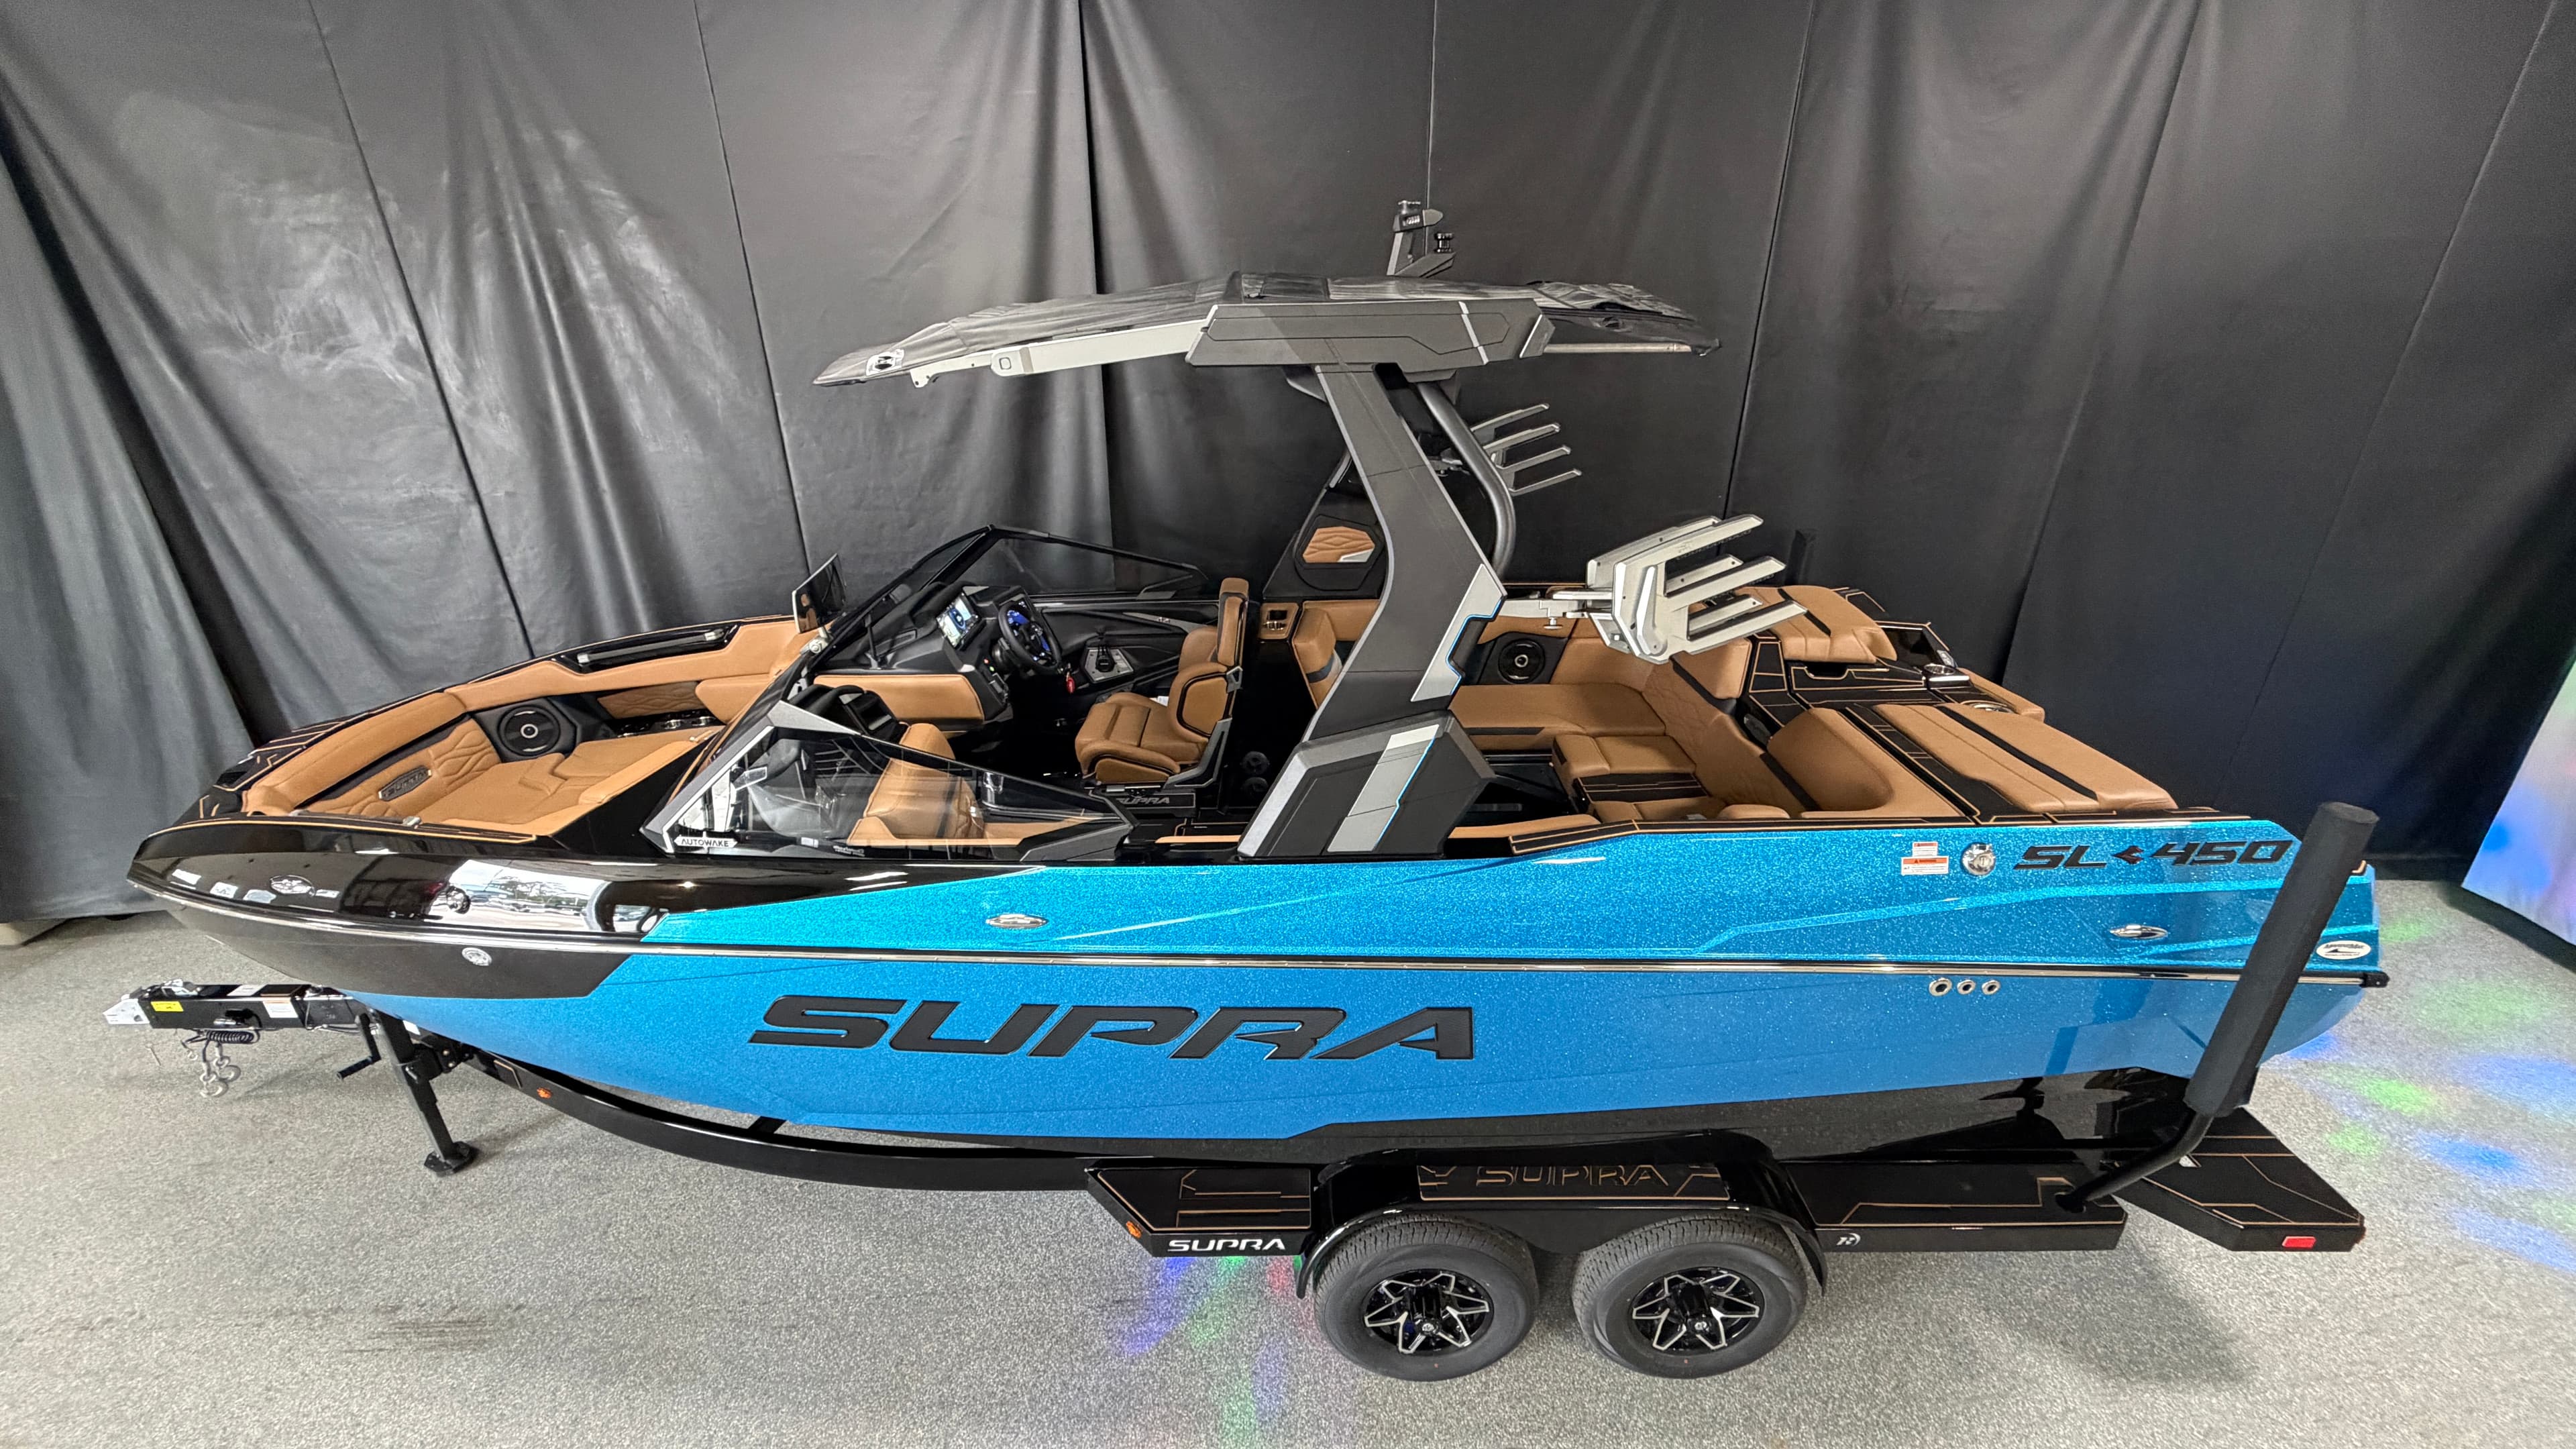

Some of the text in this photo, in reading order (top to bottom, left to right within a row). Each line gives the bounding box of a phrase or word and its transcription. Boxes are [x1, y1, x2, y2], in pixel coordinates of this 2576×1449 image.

[681, 838, 729, 847] AUTOWAKE
[2013, 840, 2294, 870] SL 450
[747, 995, 1474, 1061] SUPRA
[1476, 1165, 1669, 1186] SUPRA
[1167, 1238, 1286, 1252] SUPRA
